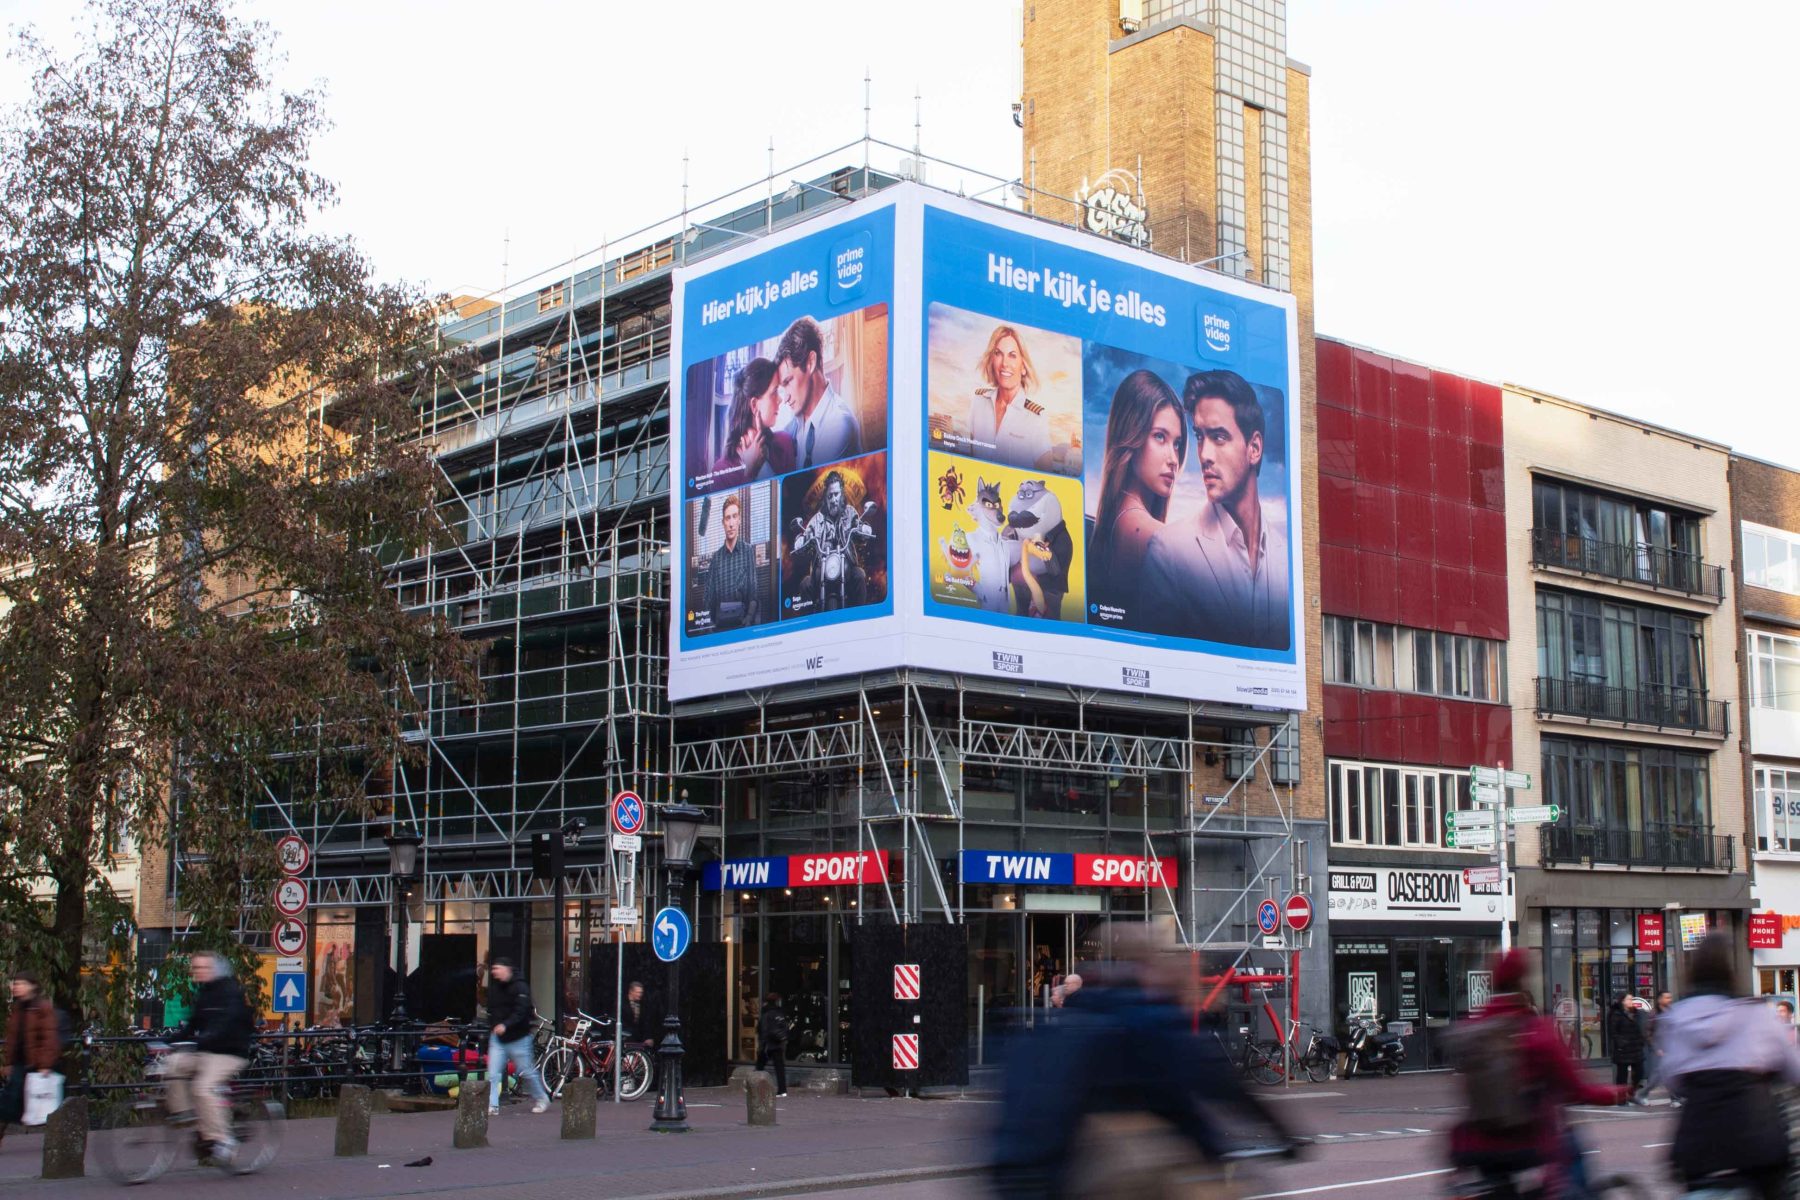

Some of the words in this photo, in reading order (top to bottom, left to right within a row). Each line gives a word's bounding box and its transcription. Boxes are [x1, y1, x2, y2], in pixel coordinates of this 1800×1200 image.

[837, 247, 864, 268] prime
[837, 262, 863, 279] video
[702, 299, 735, 326] Hier
[735, 286, 763, 315] kijk
[763, 281, 780, 309] je
[781, 269, 819, 298] alles
[987, 253, 1041, 293] Hier
[1043, 267, 1088, 308] kijk
[1087, 279, 1112, 314] je
[1114, 290, 1167, 327] alles
[1204, 314, 1230, 330] prime
[1205, 327, 1230, 343] video
[996, 652, 1019, 664] TWIN
[997, 662, 1019, 673] SPORT
[1126, 668, 1146, 678] TWIN
[1126, 676, 1146, 687] SPORT
[720, 861, 770, 885] TWIN
[802, 855, 869, 882] SPORT
[986, 855, 1052, 880] TWIN
[1091, 859, 1163, 883] SPORT
[1332, 874, 1350, 889] GRILL
[1350, 875, 1356, 889] &
[1355, 875, 1374, 890] PIZZA
[1387, 871, 1460, 904] OASEBOOM
[1352, 977, 1374, 995] OASE
[1471, 975, 1491, 992] OASE
